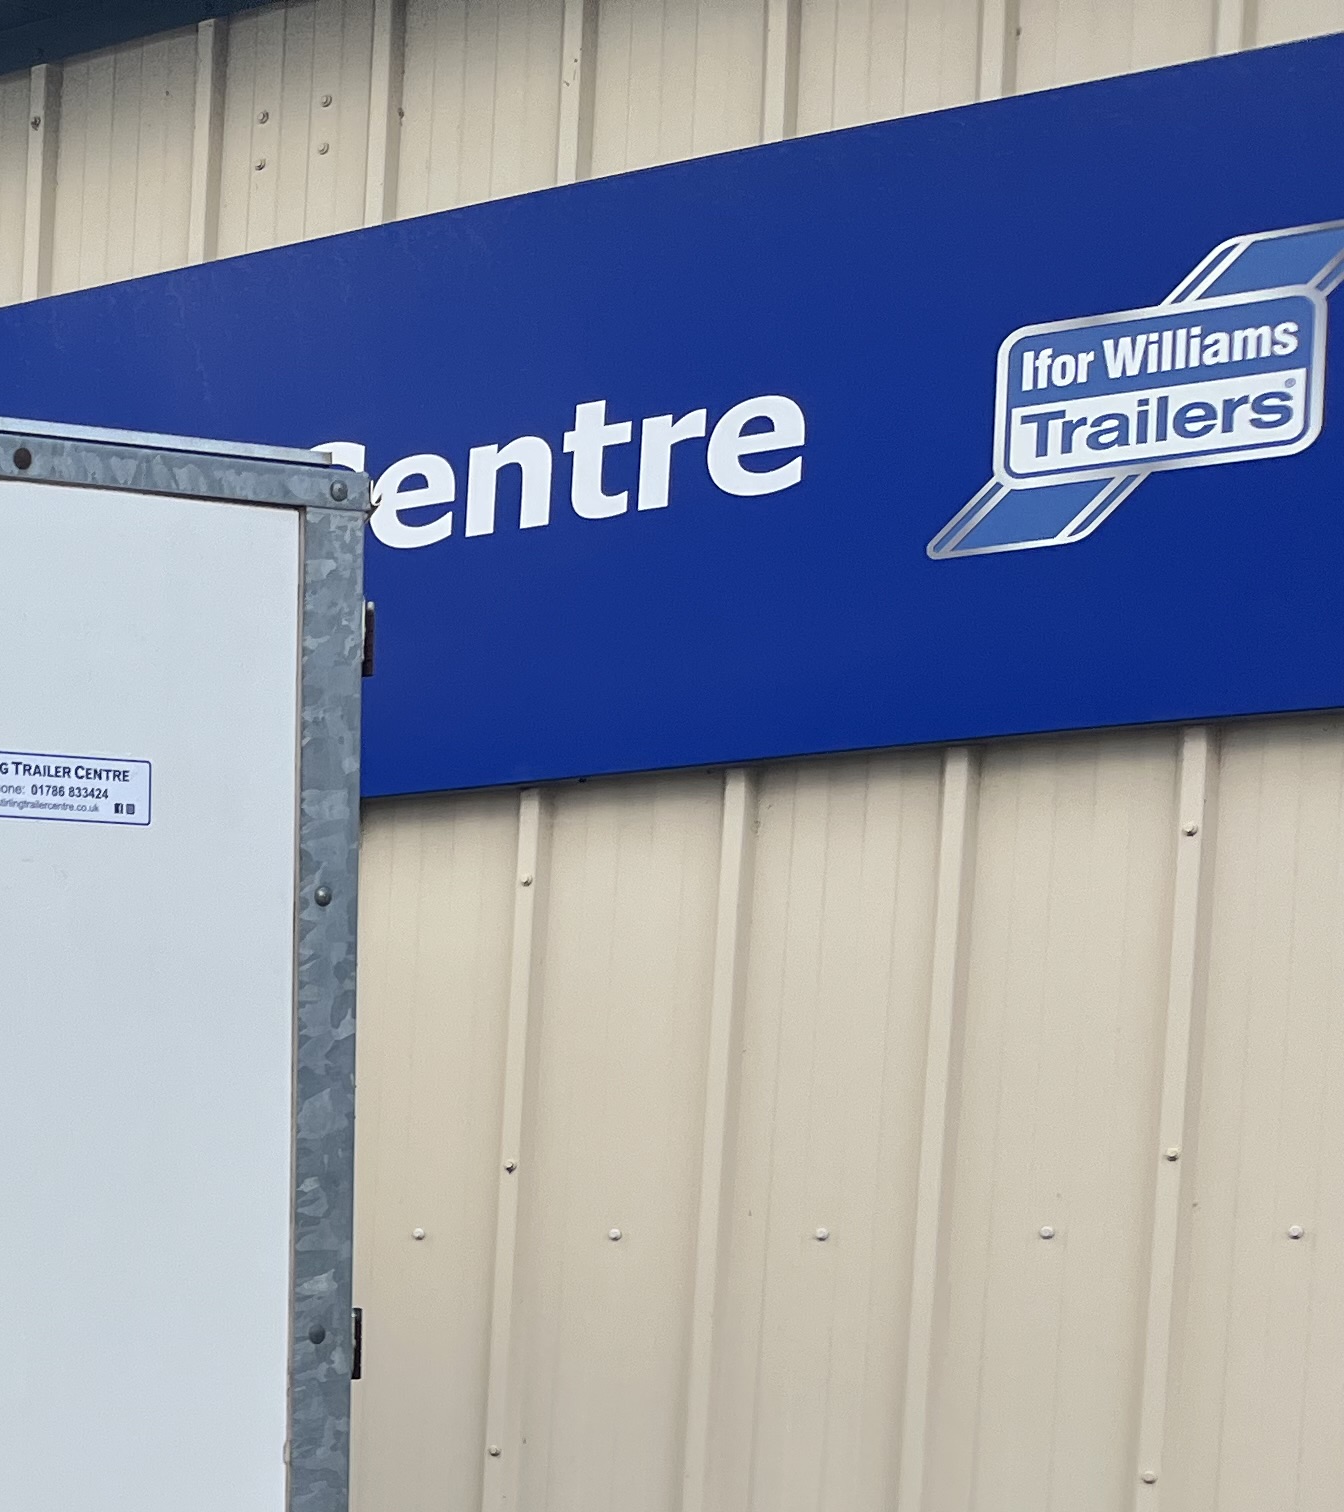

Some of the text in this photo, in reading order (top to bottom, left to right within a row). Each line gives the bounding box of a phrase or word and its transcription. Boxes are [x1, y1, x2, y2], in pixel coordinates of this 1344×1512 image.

[1021, 321, 1300, 392] Ifor Williams
[1020, 390, 1295, 459] Trailers
[310, 395, 806, 550] entre
[12, 761, 71, 779] TRAILER
[74, 765, 130, 783] CENTRE
[31, 783, 65, 798] 01786
[68, 786, 109, 800] 833424
